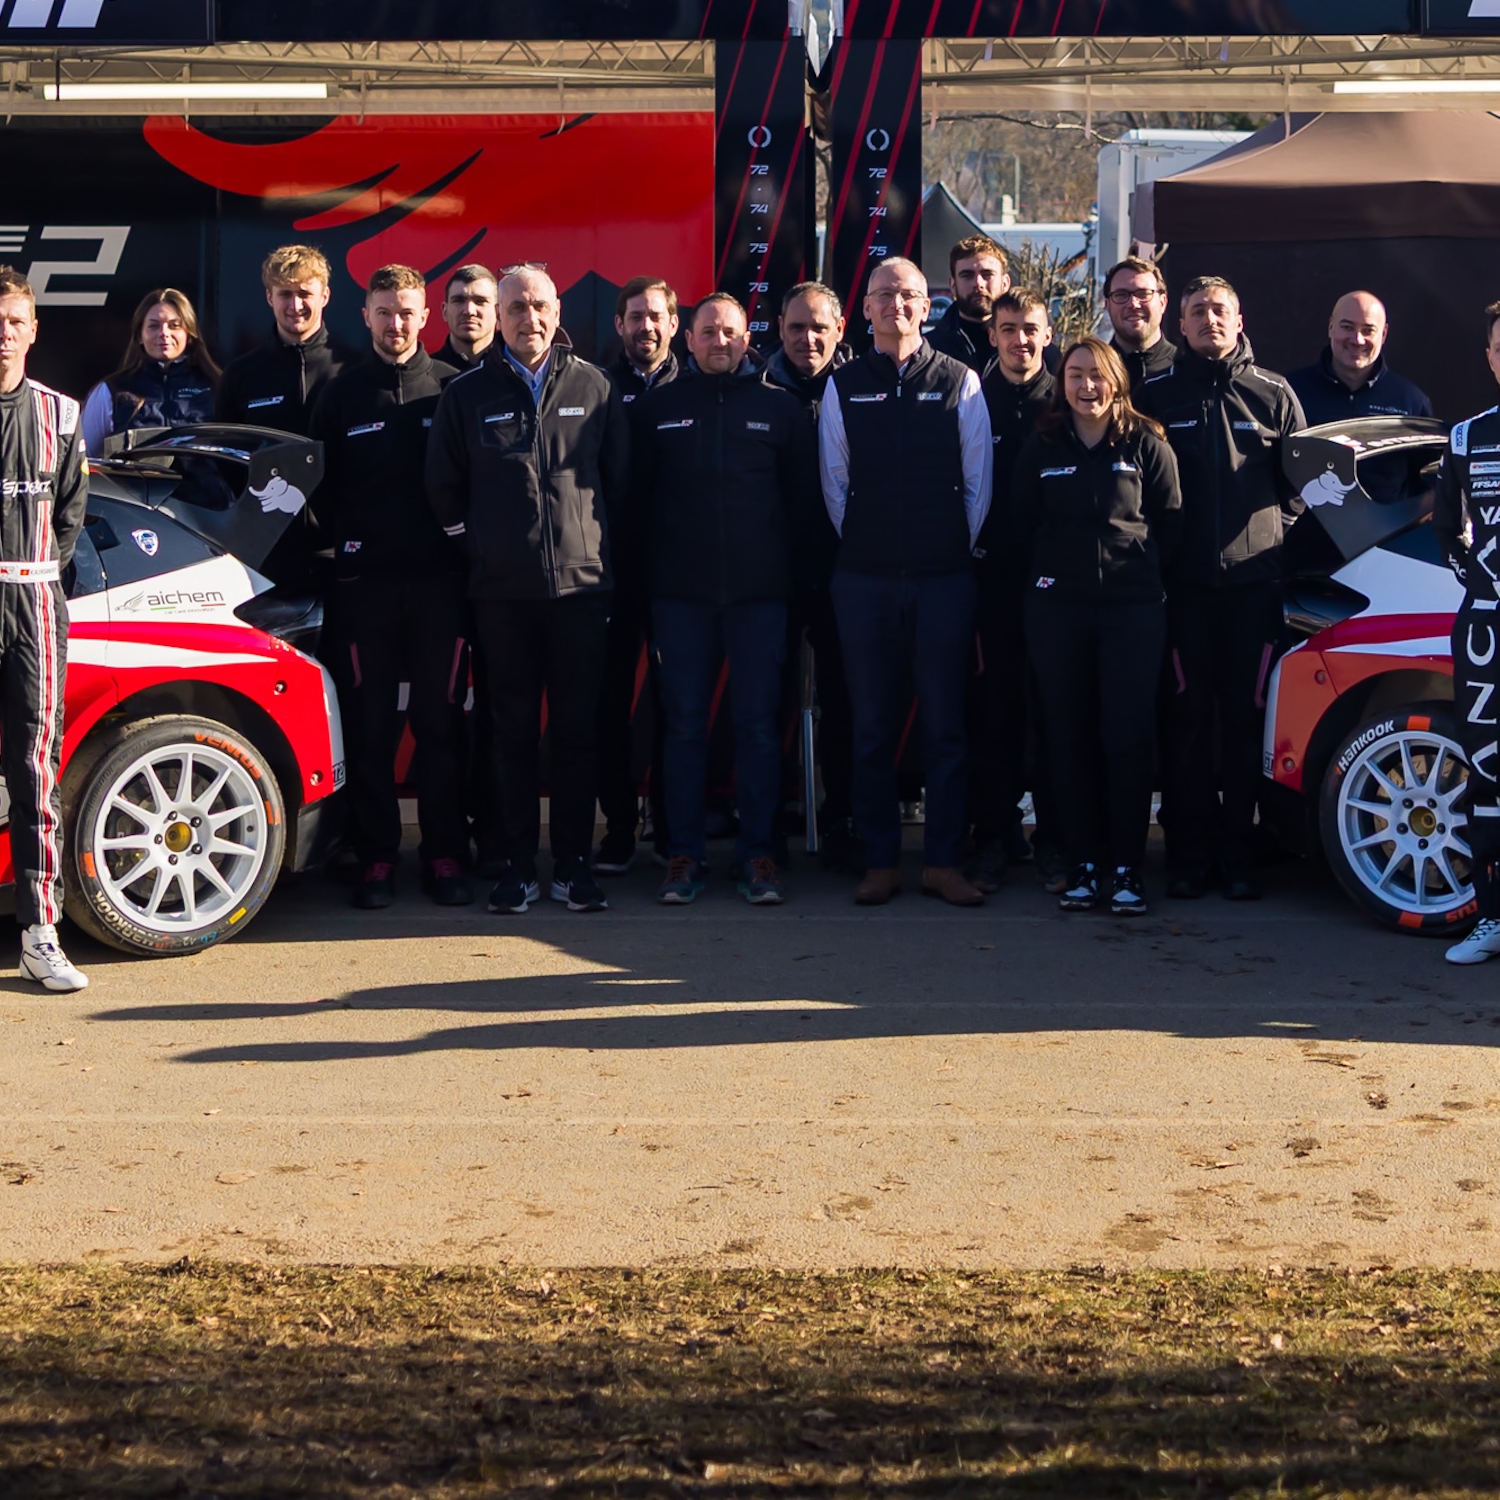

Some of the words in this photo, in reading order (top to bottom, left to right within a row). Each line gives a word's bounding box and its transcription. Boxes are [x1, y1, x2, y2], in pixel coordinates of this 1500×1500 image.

[750, 165, 769, 175] 72
[868, 168, 888, 178] 72
[750, 204, 769, 214] 74
[868, 207, 887, 217] 74
[749, 243, 769, 253] 75
[868, 246, 887, 256] 75
[26, 225, 132, 307] 2
[748, 282, 769, 292] 76
[749, 321, 769, 332] 83
[147, 589, 225, 607] aichem
